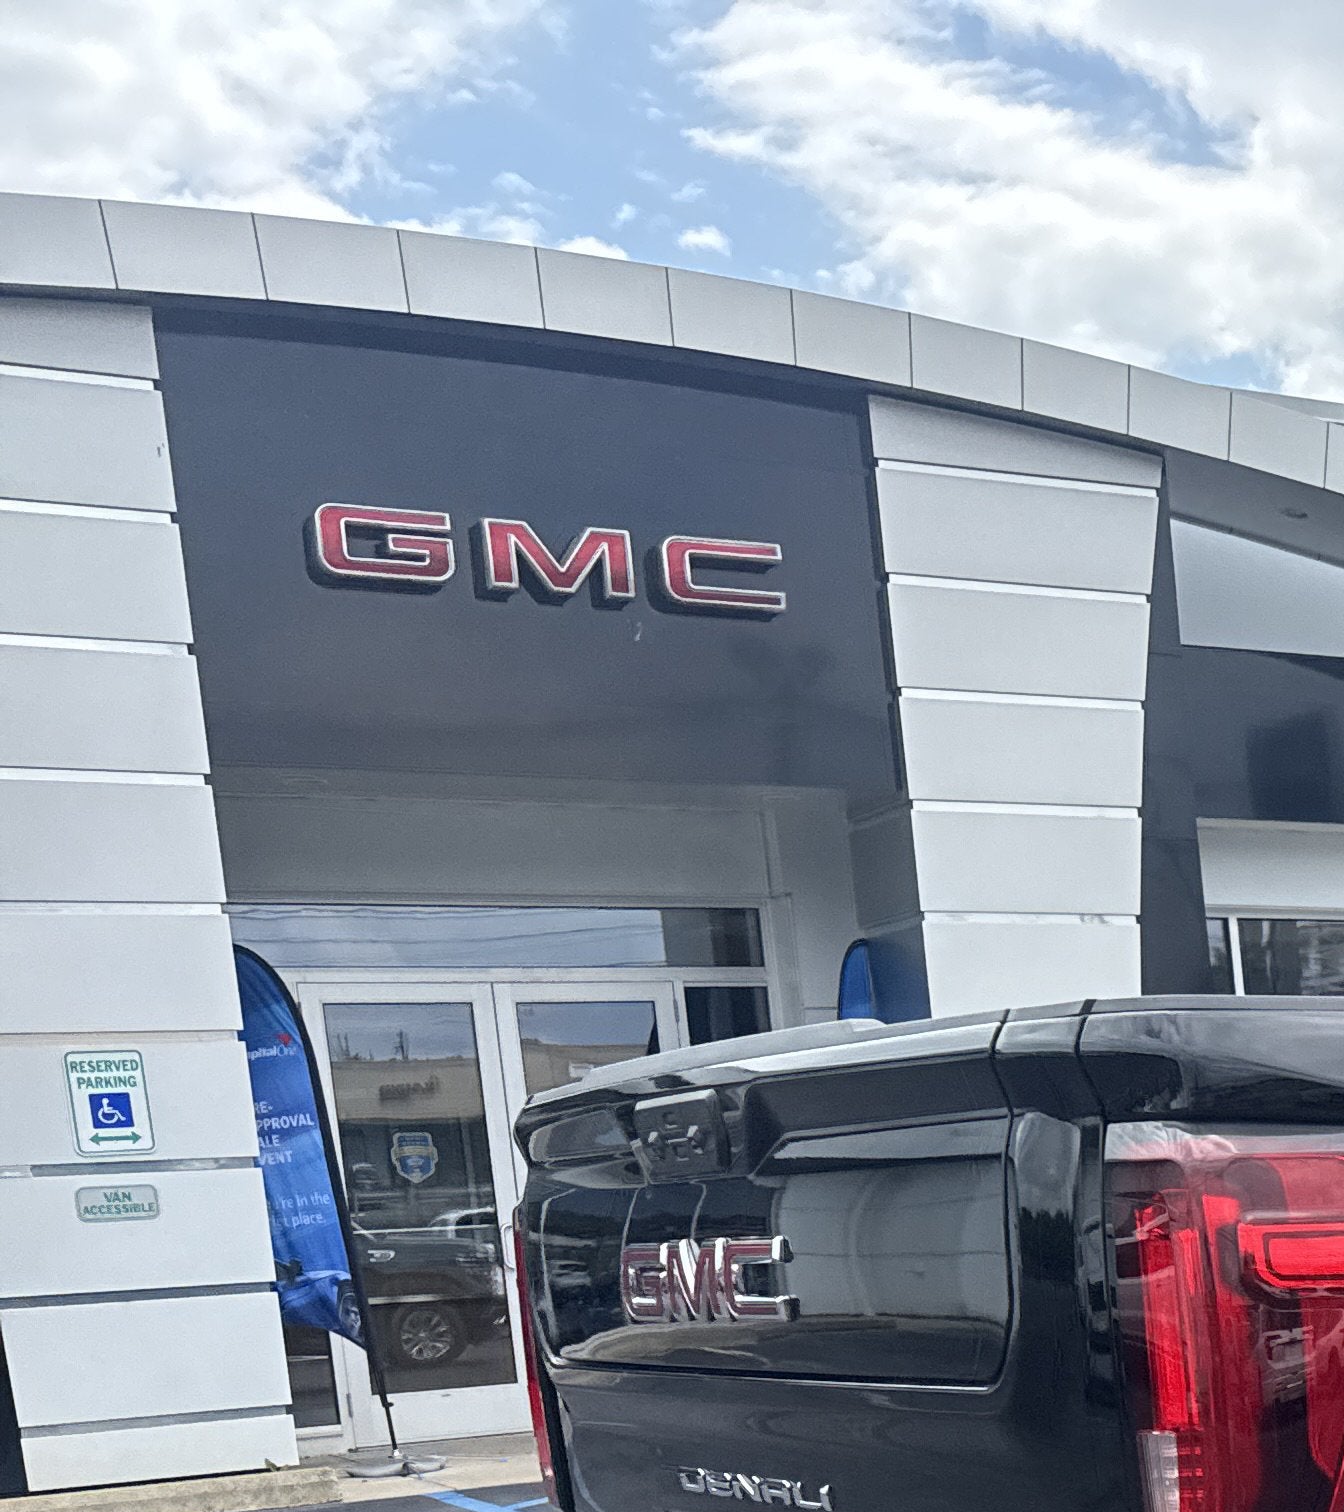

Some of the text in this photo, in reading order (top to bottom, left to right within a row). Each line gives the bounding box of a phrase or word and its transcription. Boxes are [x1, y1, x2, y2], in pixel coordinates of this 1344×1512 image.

[310, 501, 787, 613] GMC
[69, 1059, 139, 1074] RESERVED
[76, 1075, 138, 1089] PARKING
[256, 1113, 315, 1131] PPROVAL
[258, 1134, 281, 1149] ALE
[258, 1150, 293, 1166] VENT
[102, 1191, 133, 1203] VAN
[310, 1191, 331, 1206] the
[82, 1202, 156, 1216] ACCESSIBLE
[620, 1235, 801, 1325] GMC
[678, 1466, 834, 1512] DENALI
